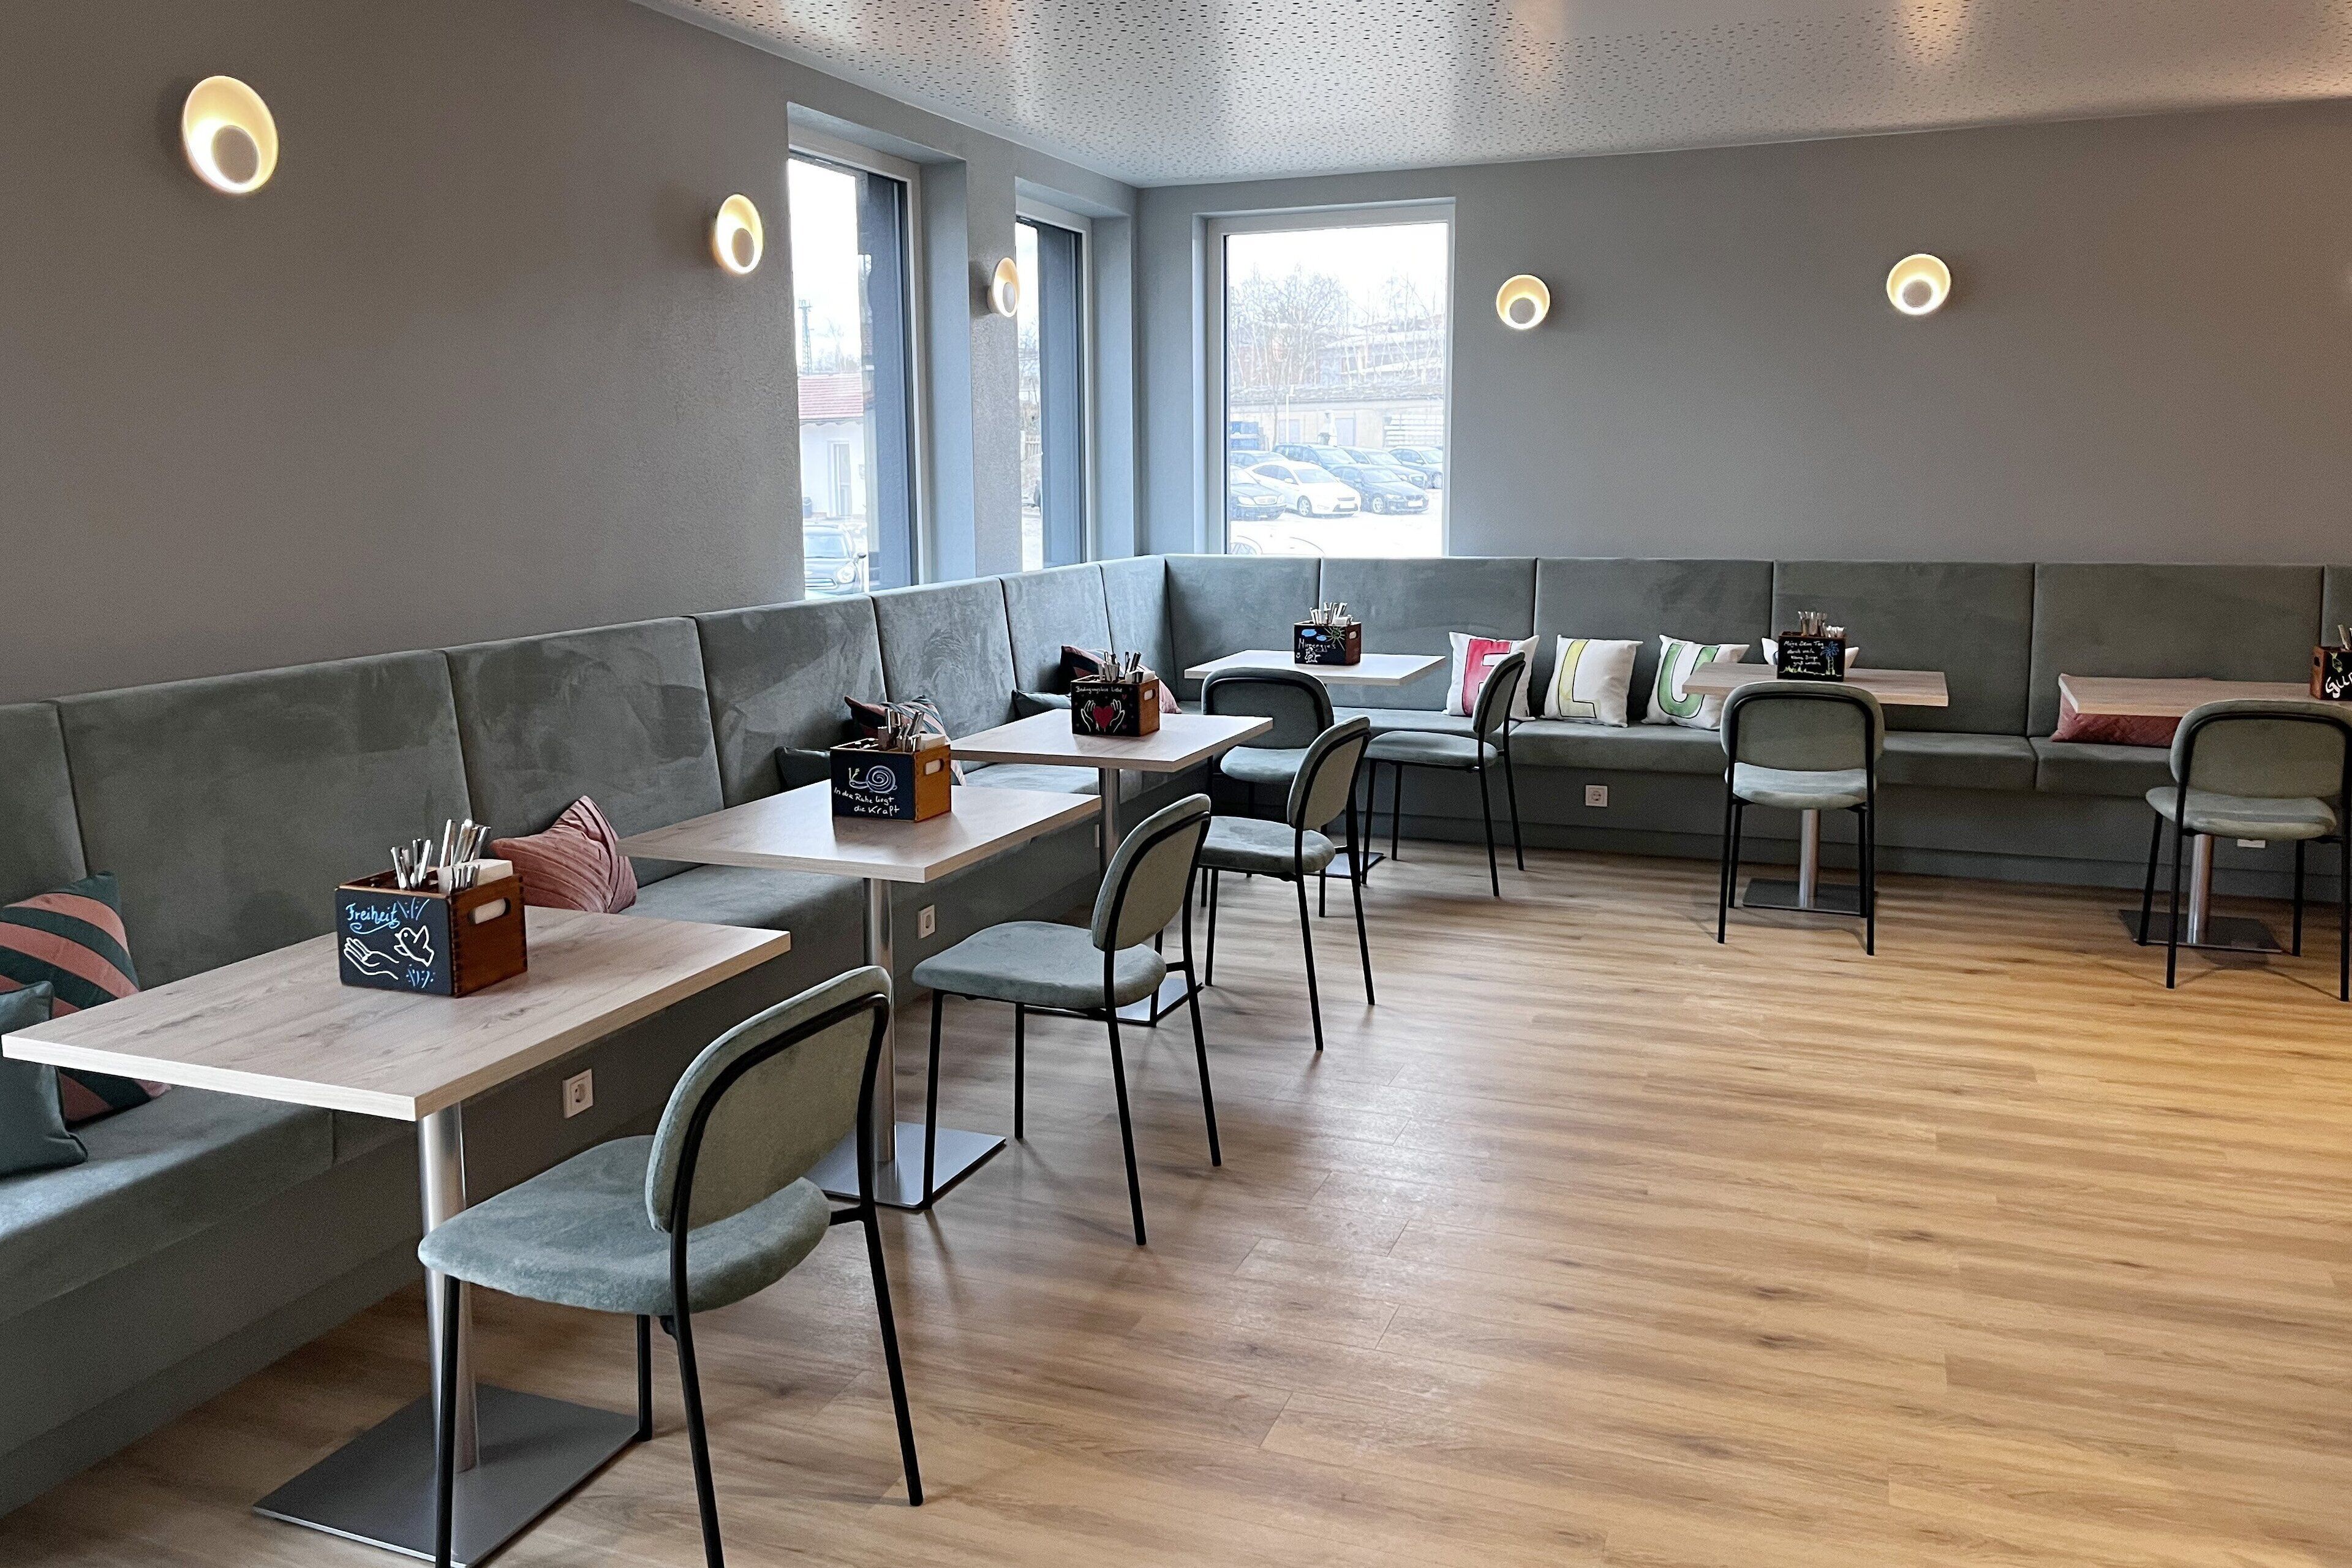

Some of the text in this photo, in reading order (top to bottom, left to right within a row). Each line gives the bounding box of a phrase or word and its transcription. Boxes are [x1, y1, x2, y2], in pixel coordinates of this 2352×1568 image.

[1558, 639, 1600, 718] L
[1657, 641, 1721, 718] U
[834, 786, 842, 795] In
[854, 793, 873, 804] Ruhe
[875, 795, 894, 806] liegt
[345, 902, 399, 924] Freiheit
